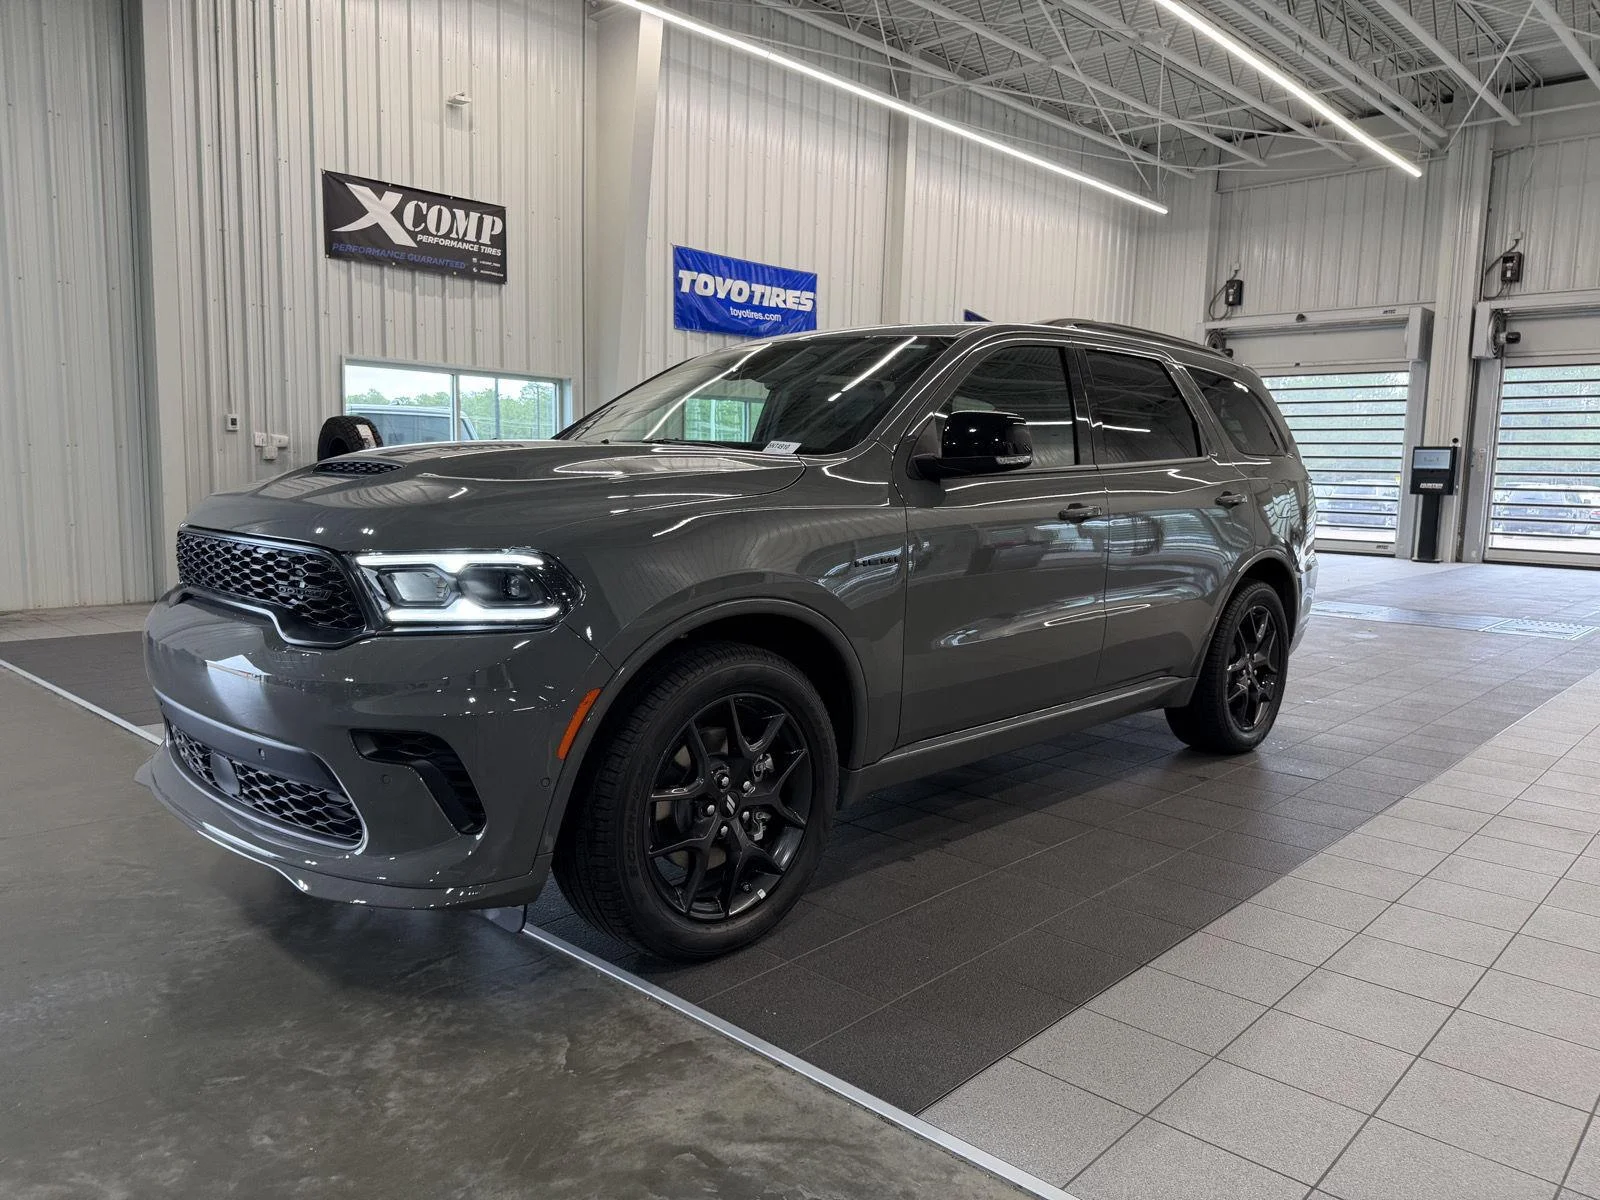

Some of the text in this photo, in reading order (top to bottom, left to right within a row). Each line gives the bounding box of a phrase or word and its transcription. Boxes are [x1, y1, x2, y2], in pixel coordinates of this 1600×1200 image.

[332, 243, 406, 260] PERFORMANCE
[407, 253, 466, 270] GUARANTEED
[416, 234, 502, 257] PERFORMANCE TIRES
[729, 306, 782, 322] toyotires.com
